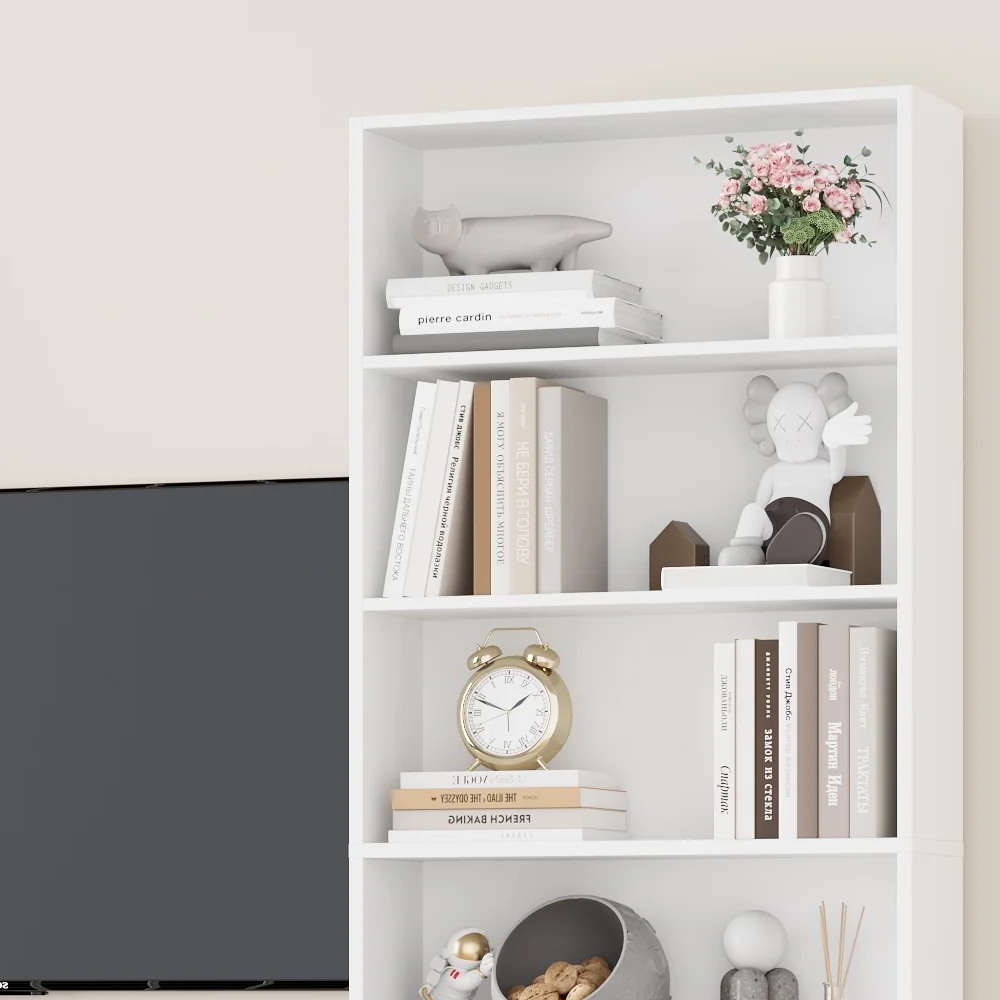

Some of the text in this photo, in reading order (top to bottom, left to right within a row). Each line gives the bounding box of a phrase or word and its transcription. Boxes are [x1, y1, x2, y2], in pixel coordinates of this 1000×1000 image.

[418, 315, 452, 325] pierre
[455, 312, 492, 322] cardin
[517, 441, 529, 458] НЕ
[446, 456, 460, 494] Религия
[517, 461, 529, 496] БЕРИ
[517, 499, 529, 509] В
[432, 529, 445, 578] водолазки
[517, 513, 529, 564] ГОЛОВУ
[392, 542, 404, 581] ВОСТОКА
[784, 692, 792, 721] Джобс
[825, 722, 842, 806] Мартин Иден
[857, 747, 869, 814] ТРАКТАТЫ
[717, 765, 731, 814] Спартак
